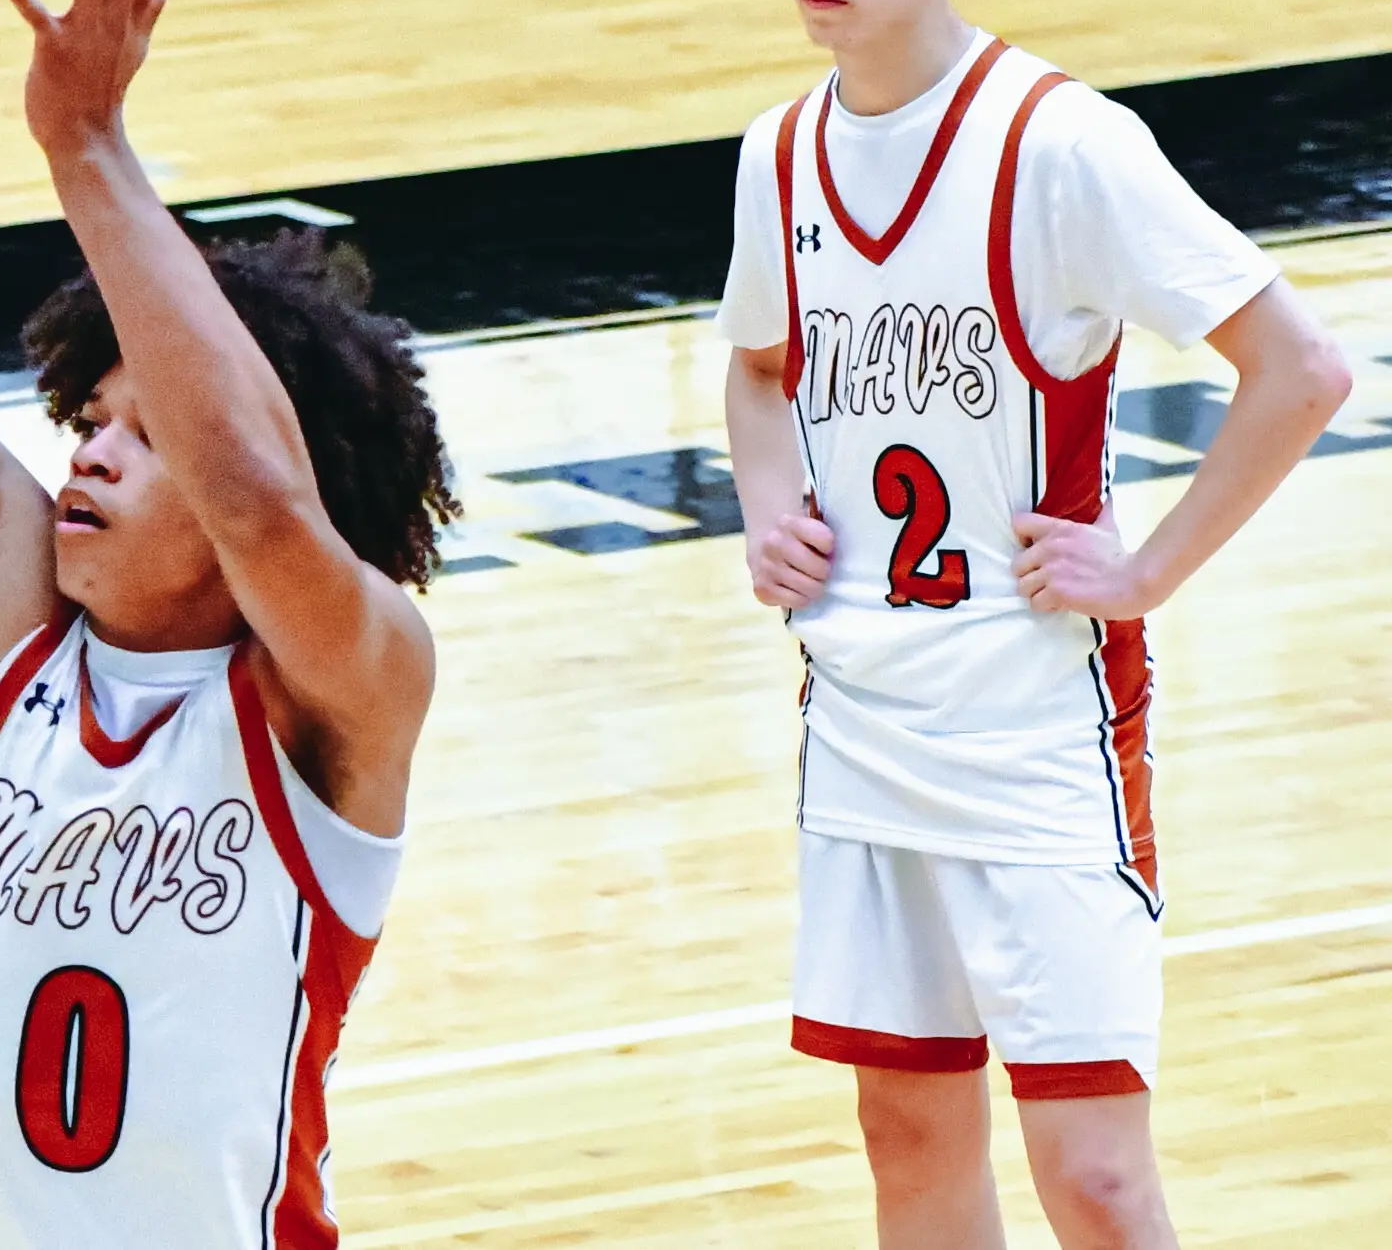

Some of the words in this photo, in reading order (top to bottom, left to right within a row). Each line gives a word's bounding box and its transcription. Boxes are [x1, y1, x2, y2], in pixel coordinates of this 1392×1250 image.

[805, 302, 996, 424] MAVS
[873, 443, 970, 609] 2
[15, 964, 130, 1174] 0
